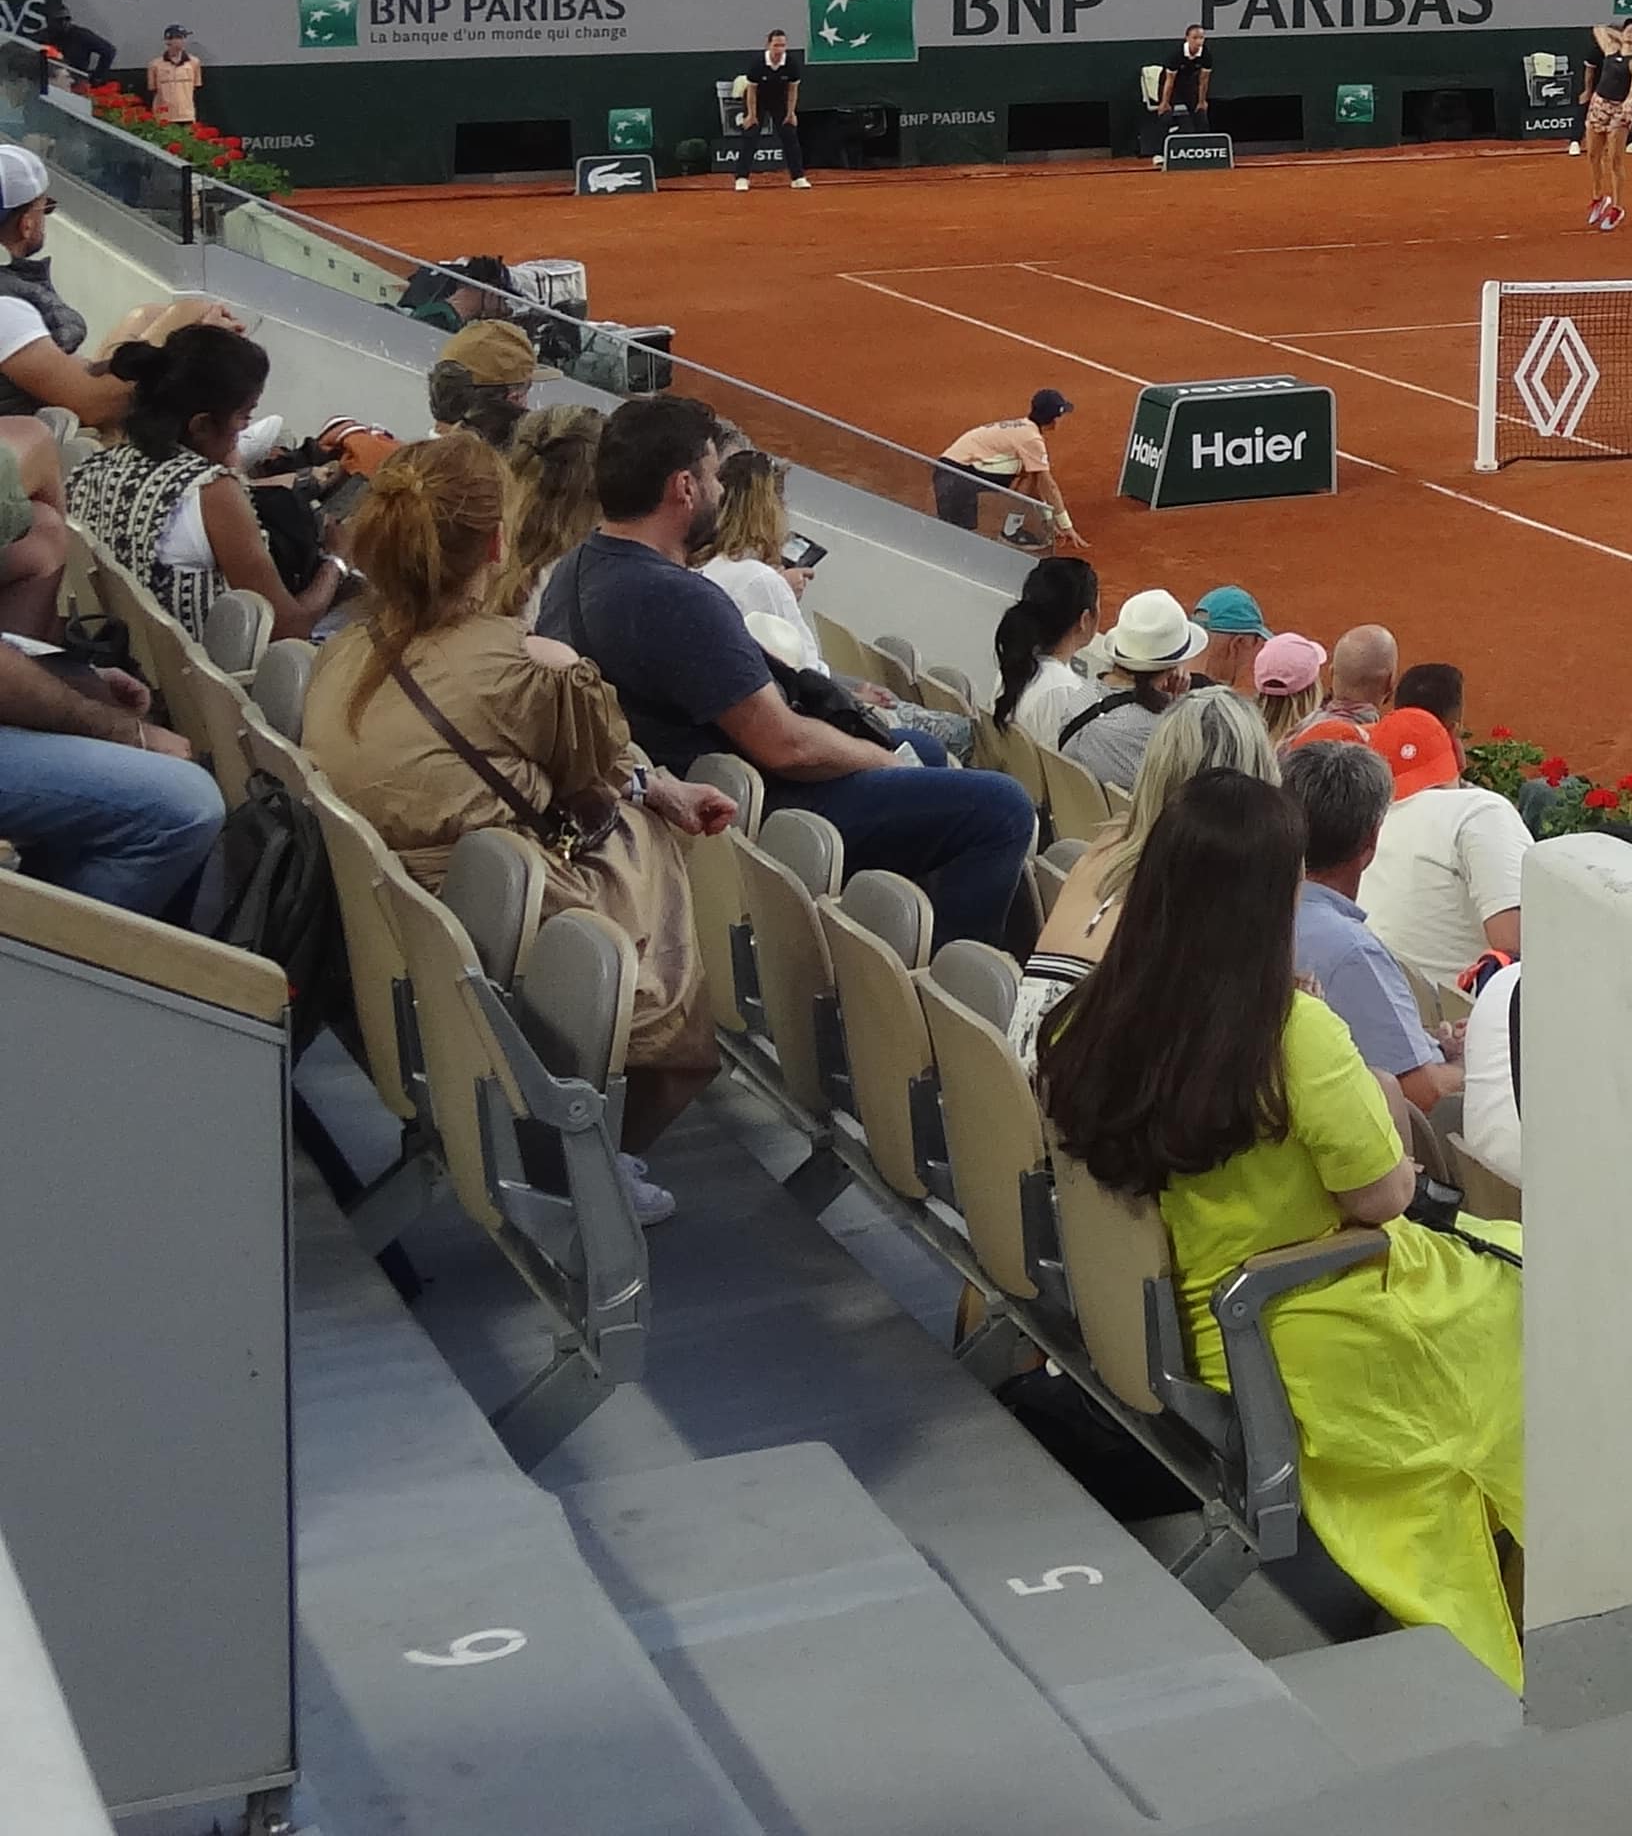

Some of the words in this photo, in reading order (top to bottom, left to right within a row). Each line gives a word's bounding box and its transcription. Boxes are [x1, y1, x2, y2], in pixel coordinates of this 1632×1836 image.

[370, 32, 387, 43] La
[392, 31, 448, 45] banque
[453, 29, 486, 41] d'un
[492, 28, 542, 40] monde
[547, 27, 570, 42] qui
[575, 26, 627, 40] change
[900, 114, 928, 127] BNP
[932, 111, 996, 124] PARIBAS
[1526, 117, 1574, 131] LACOST
[241, 134, 315, 150] PARIBAS
[716, 149, 783, 162] LASTE
[1170, 148, 1227, 159] LACOSTE
[1130, 433, 1163, 469] Haier
[1192, 426, 1307, 469] Haier
[1006, 1565, 1103, 1596] 5
